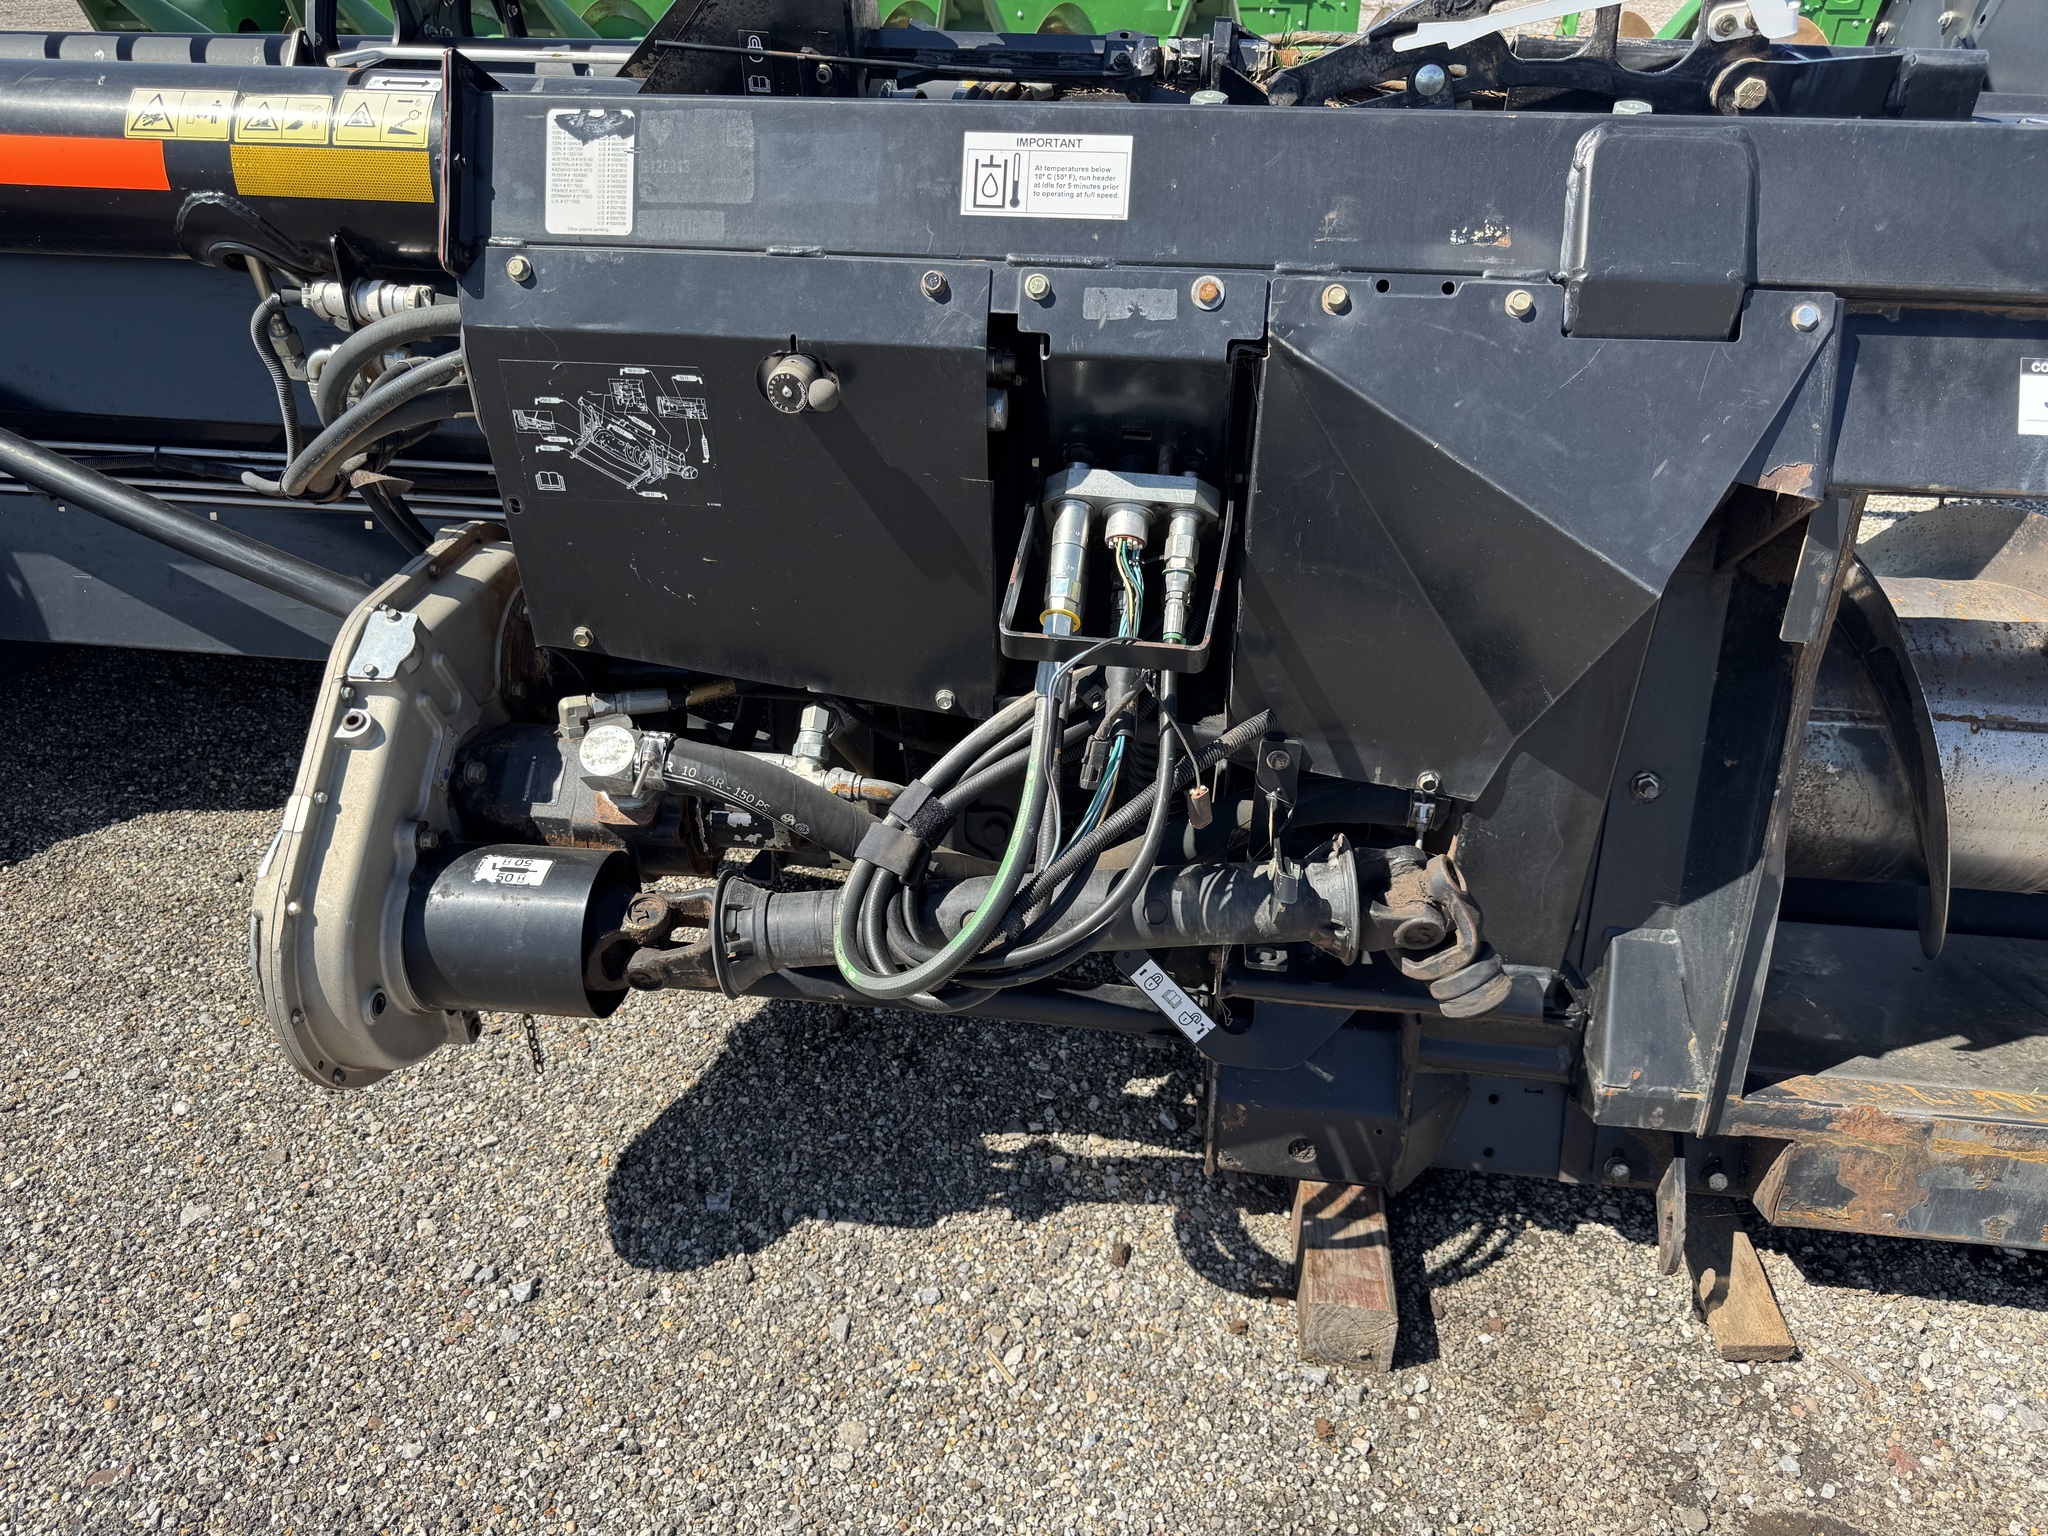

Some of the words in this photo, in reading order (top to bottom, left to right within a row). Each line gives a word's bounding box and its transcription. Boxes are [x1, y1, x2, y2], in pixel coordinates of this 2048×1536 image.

[1016, 138, 1083, 148] IMPORTANT
[682, 766, 697, 778] 10
[733, 787, 754, 803] 150
[496, 873, 514, 882] 50
